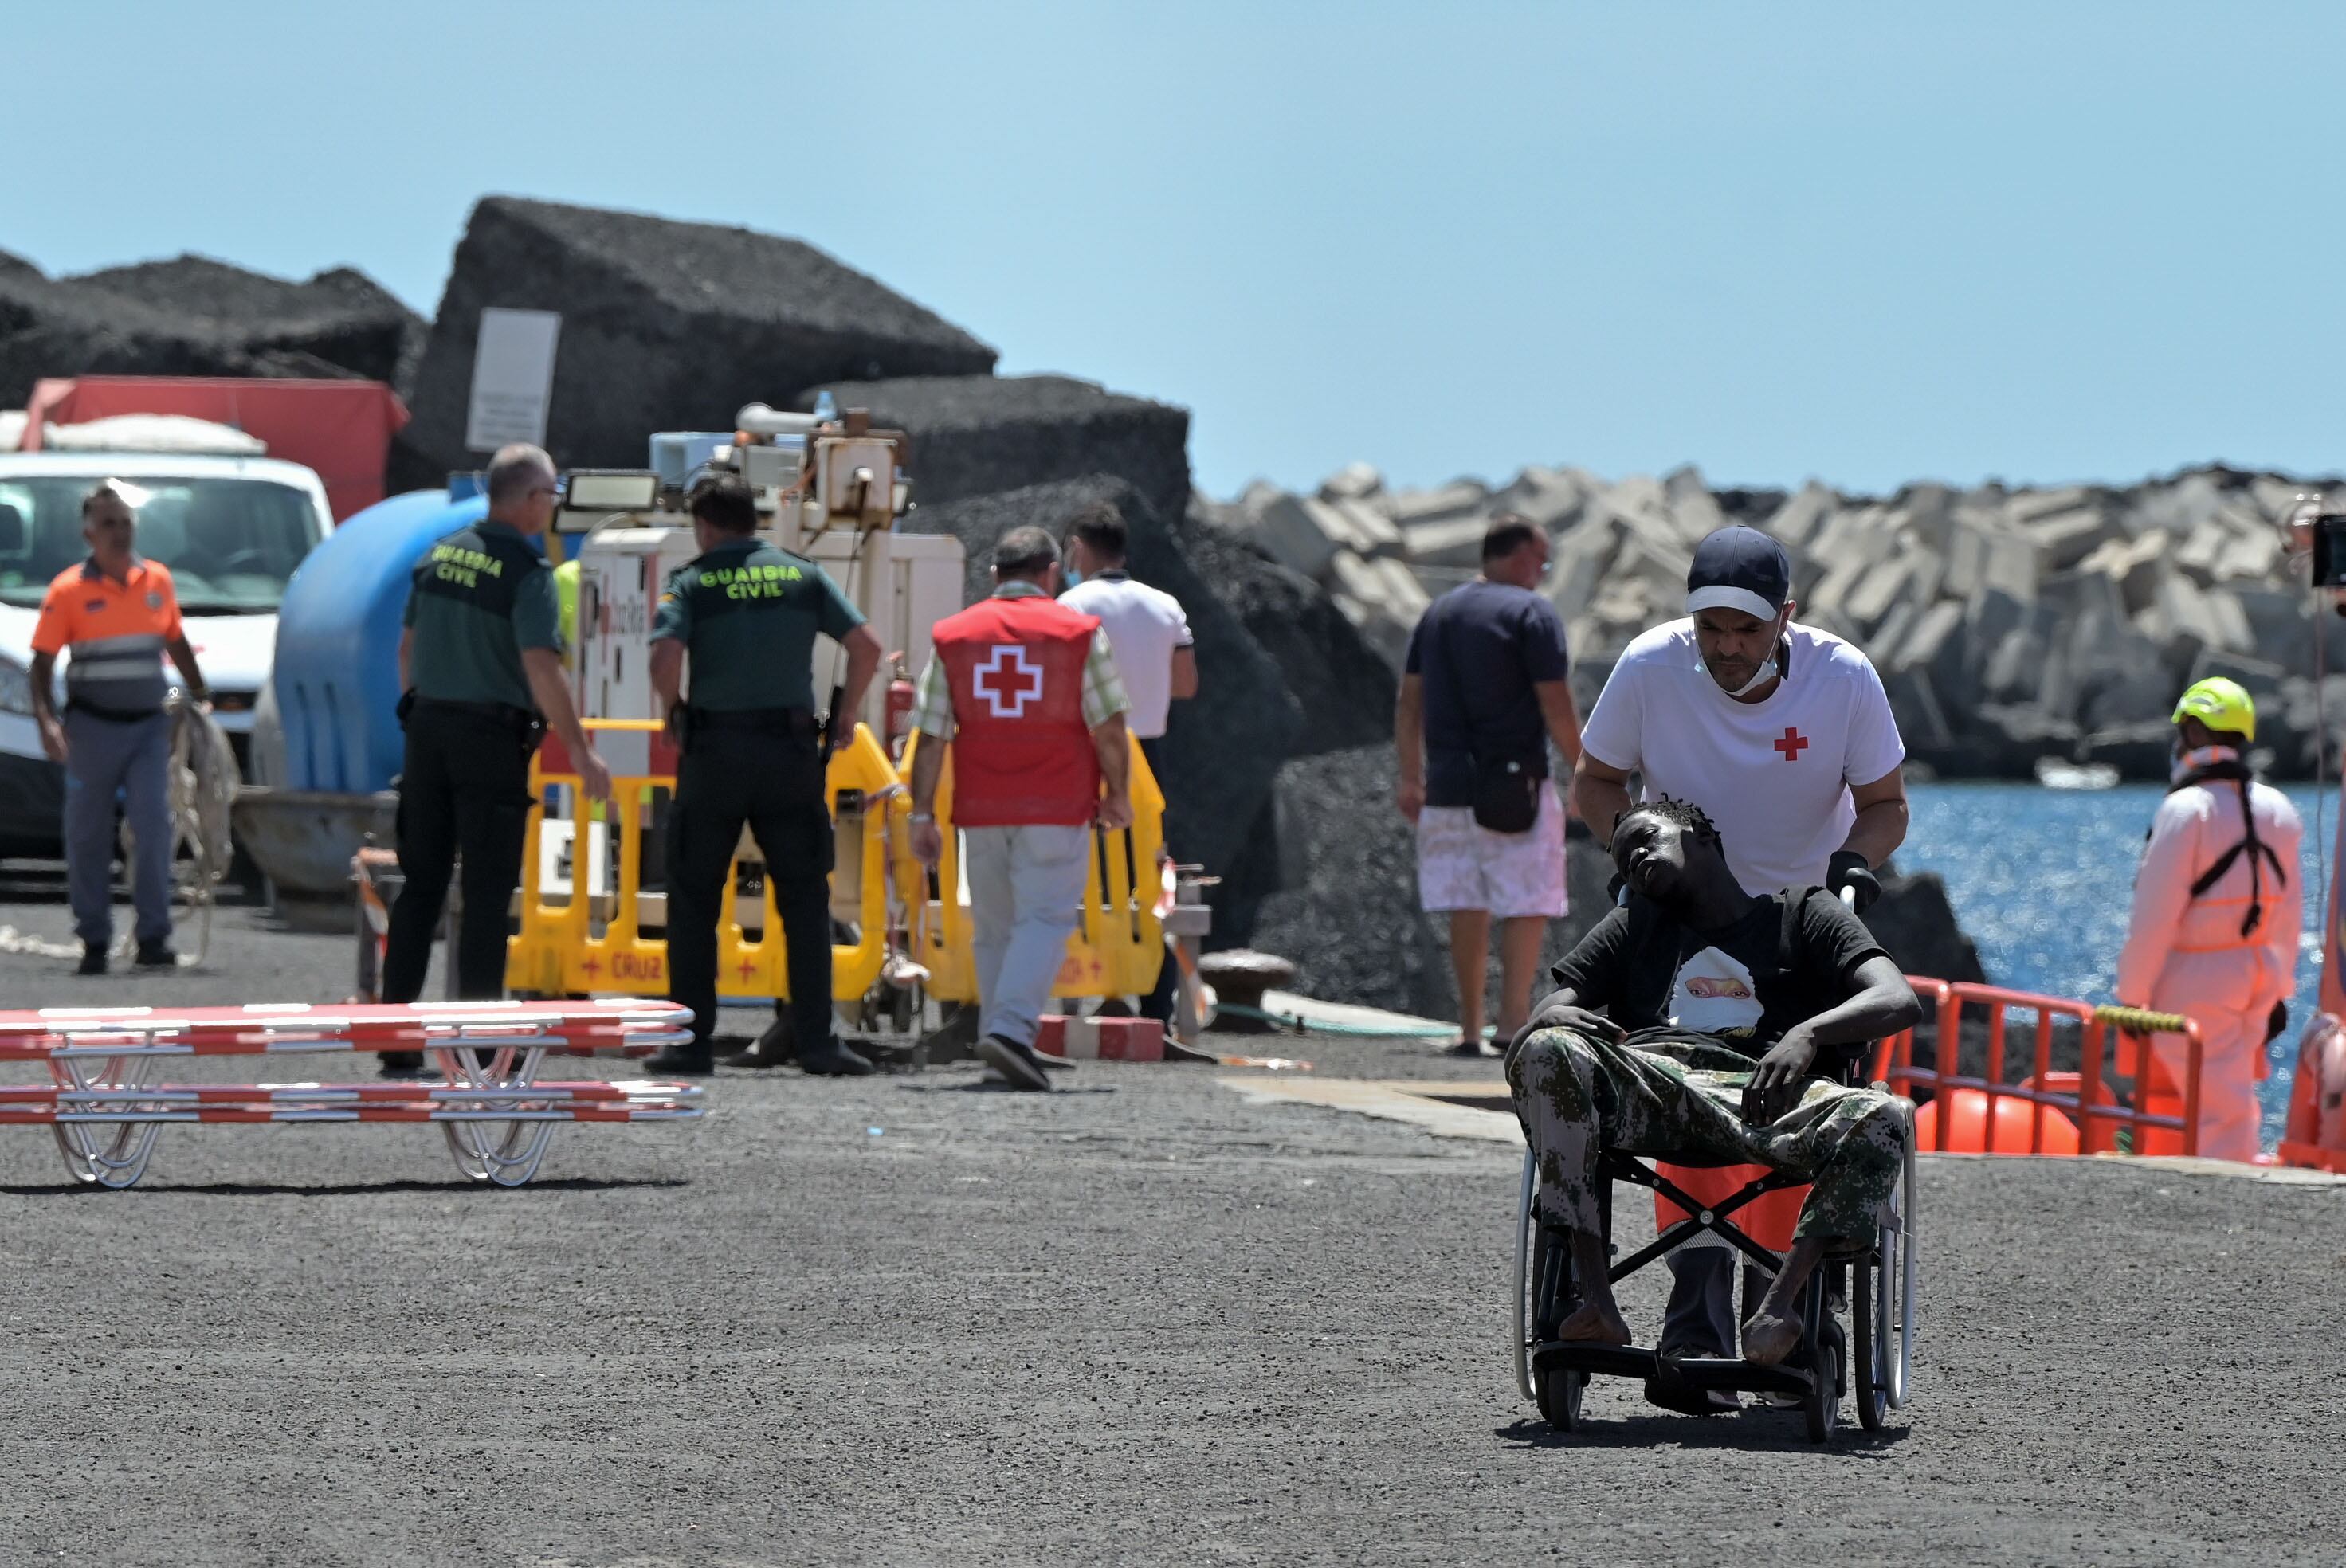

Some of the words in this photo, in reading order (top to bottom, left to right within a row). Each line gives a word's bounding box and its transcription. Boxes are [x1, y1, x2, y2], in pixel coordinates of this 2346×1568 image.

[432, 544, 504, 578] GUARDIA
[436, 563, 477, 588] CIVIL
[700, 565, 803, 588] GUARDIA
[726, 582, 784, 600] CIVIL
